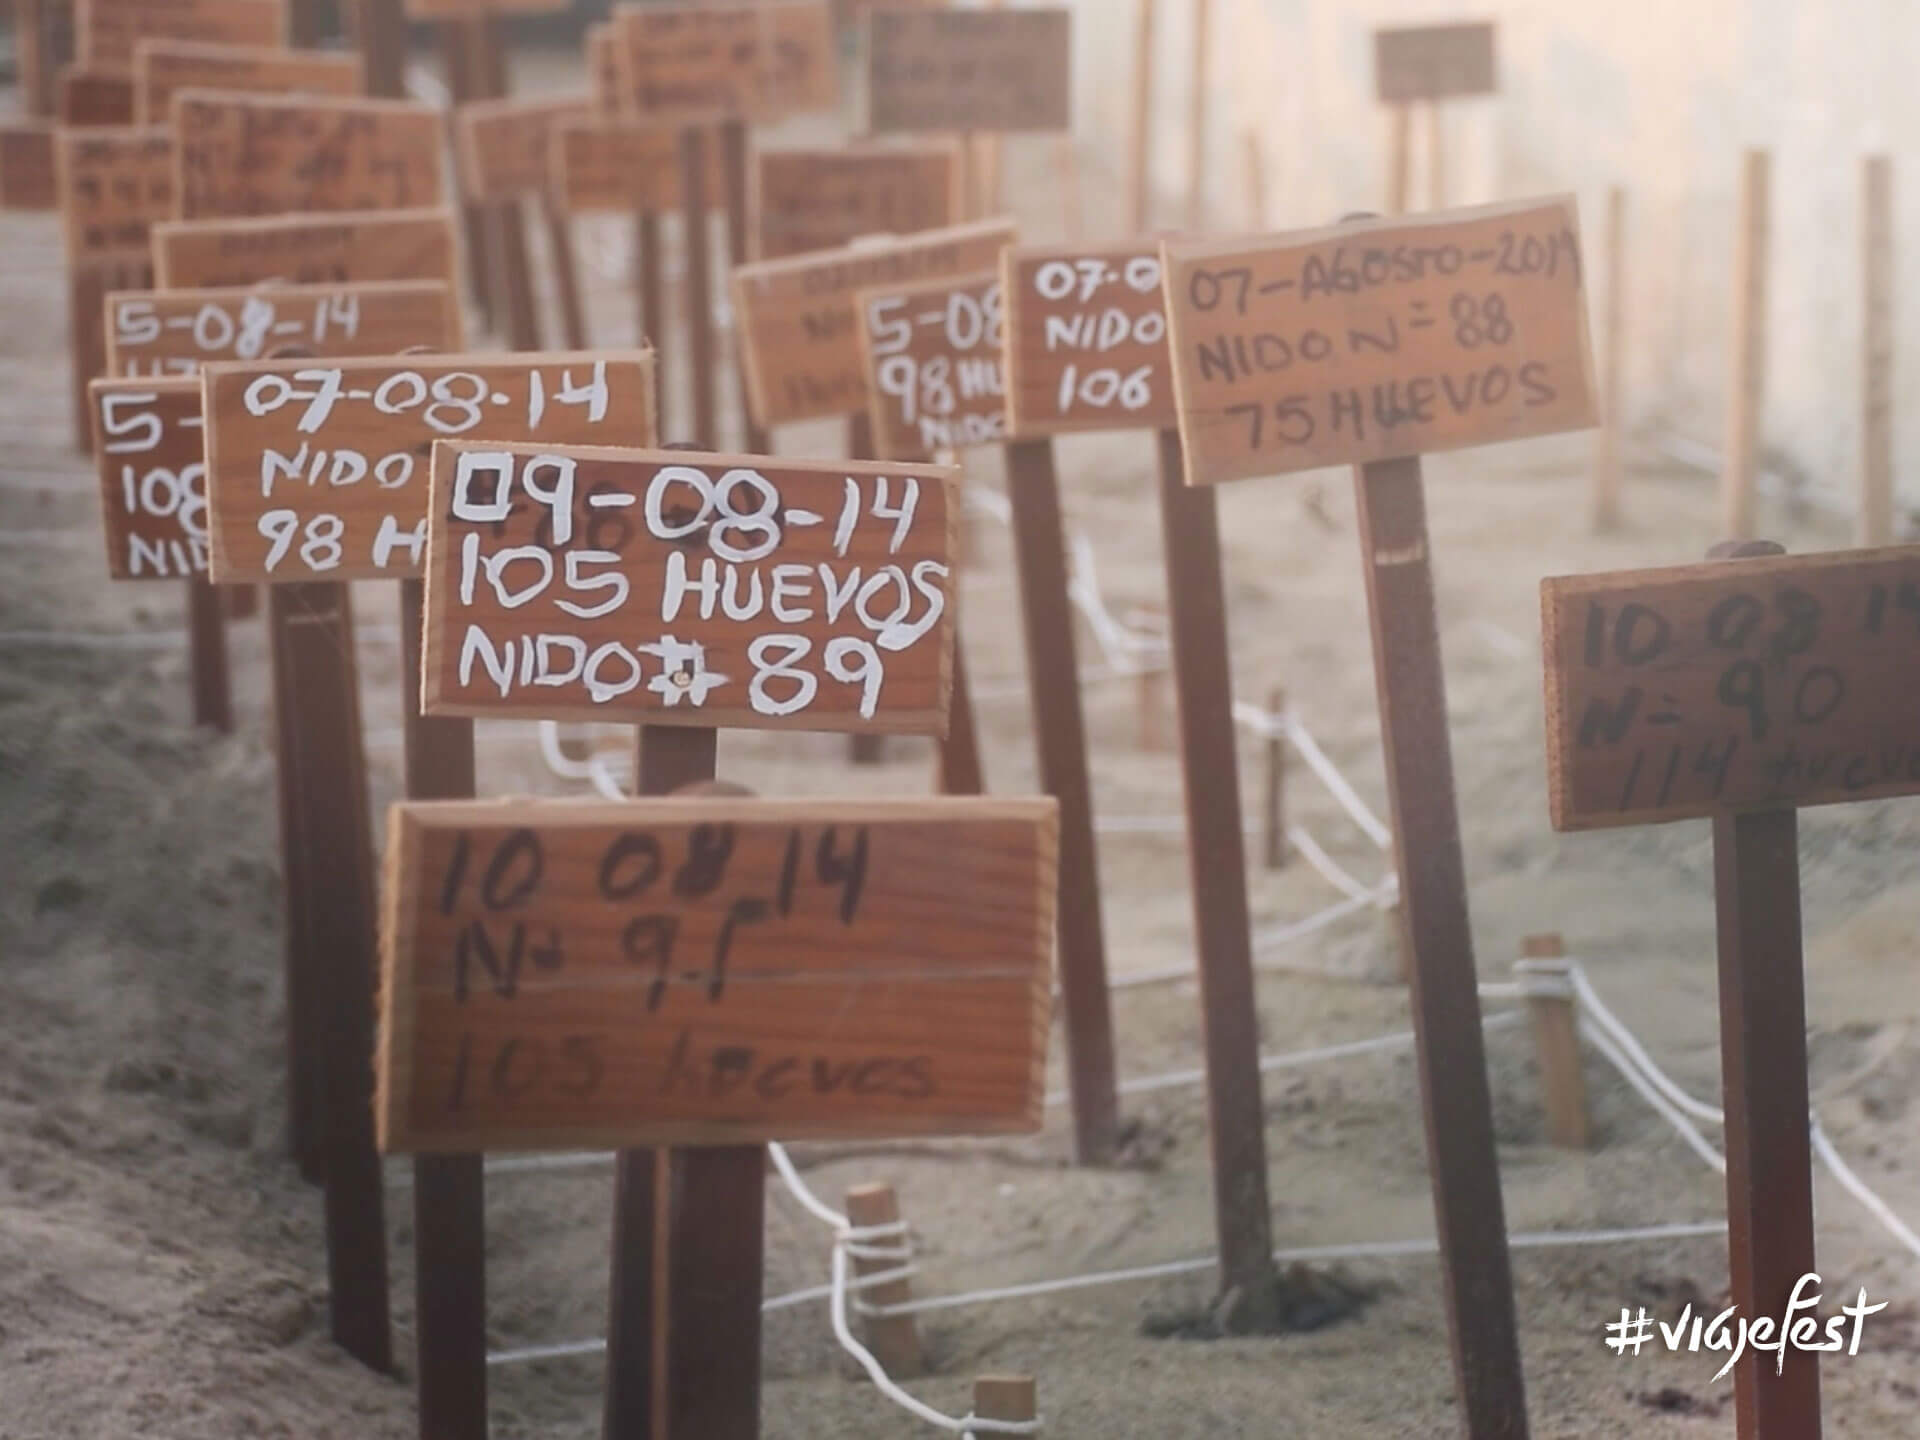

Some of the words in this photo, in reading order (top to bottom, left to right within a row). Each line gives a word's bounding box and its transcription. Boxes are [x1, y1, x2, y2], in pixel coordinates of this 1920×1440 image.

[115, 295, 360, 358] 5-08-14
[1045, 312, 1165, 351] NIDO
[1196, 332, 1333, 383] NIDO
[1450, 292, 1515, 350] 88
[877, 356, 955, 424] 98
[1058, 365, 1153, 412] 106
[1224, 396, 1316, 449] 75
[261, 441, 415, 498] NIDO
[452, 451, 920, 562] 09-08-14
[257, 509, 344, 573] 98
[460, 532, 630, 618] 105
[661, 550, 950, 652] HUEVOS
[1582, 602, 1672, 668] 10
[1707, 588, 1823, 664] 08
[747, 633, 884, 719] 89
[1718, 658, 1845, 740] 90
[1619, 735, 1738, 812] 114
[440, 826, 544, 916] 10
[597, 823, 736, 899] 08
[774, 824, 870, 924] 14
[448, 1032, 598, 1108] 105
